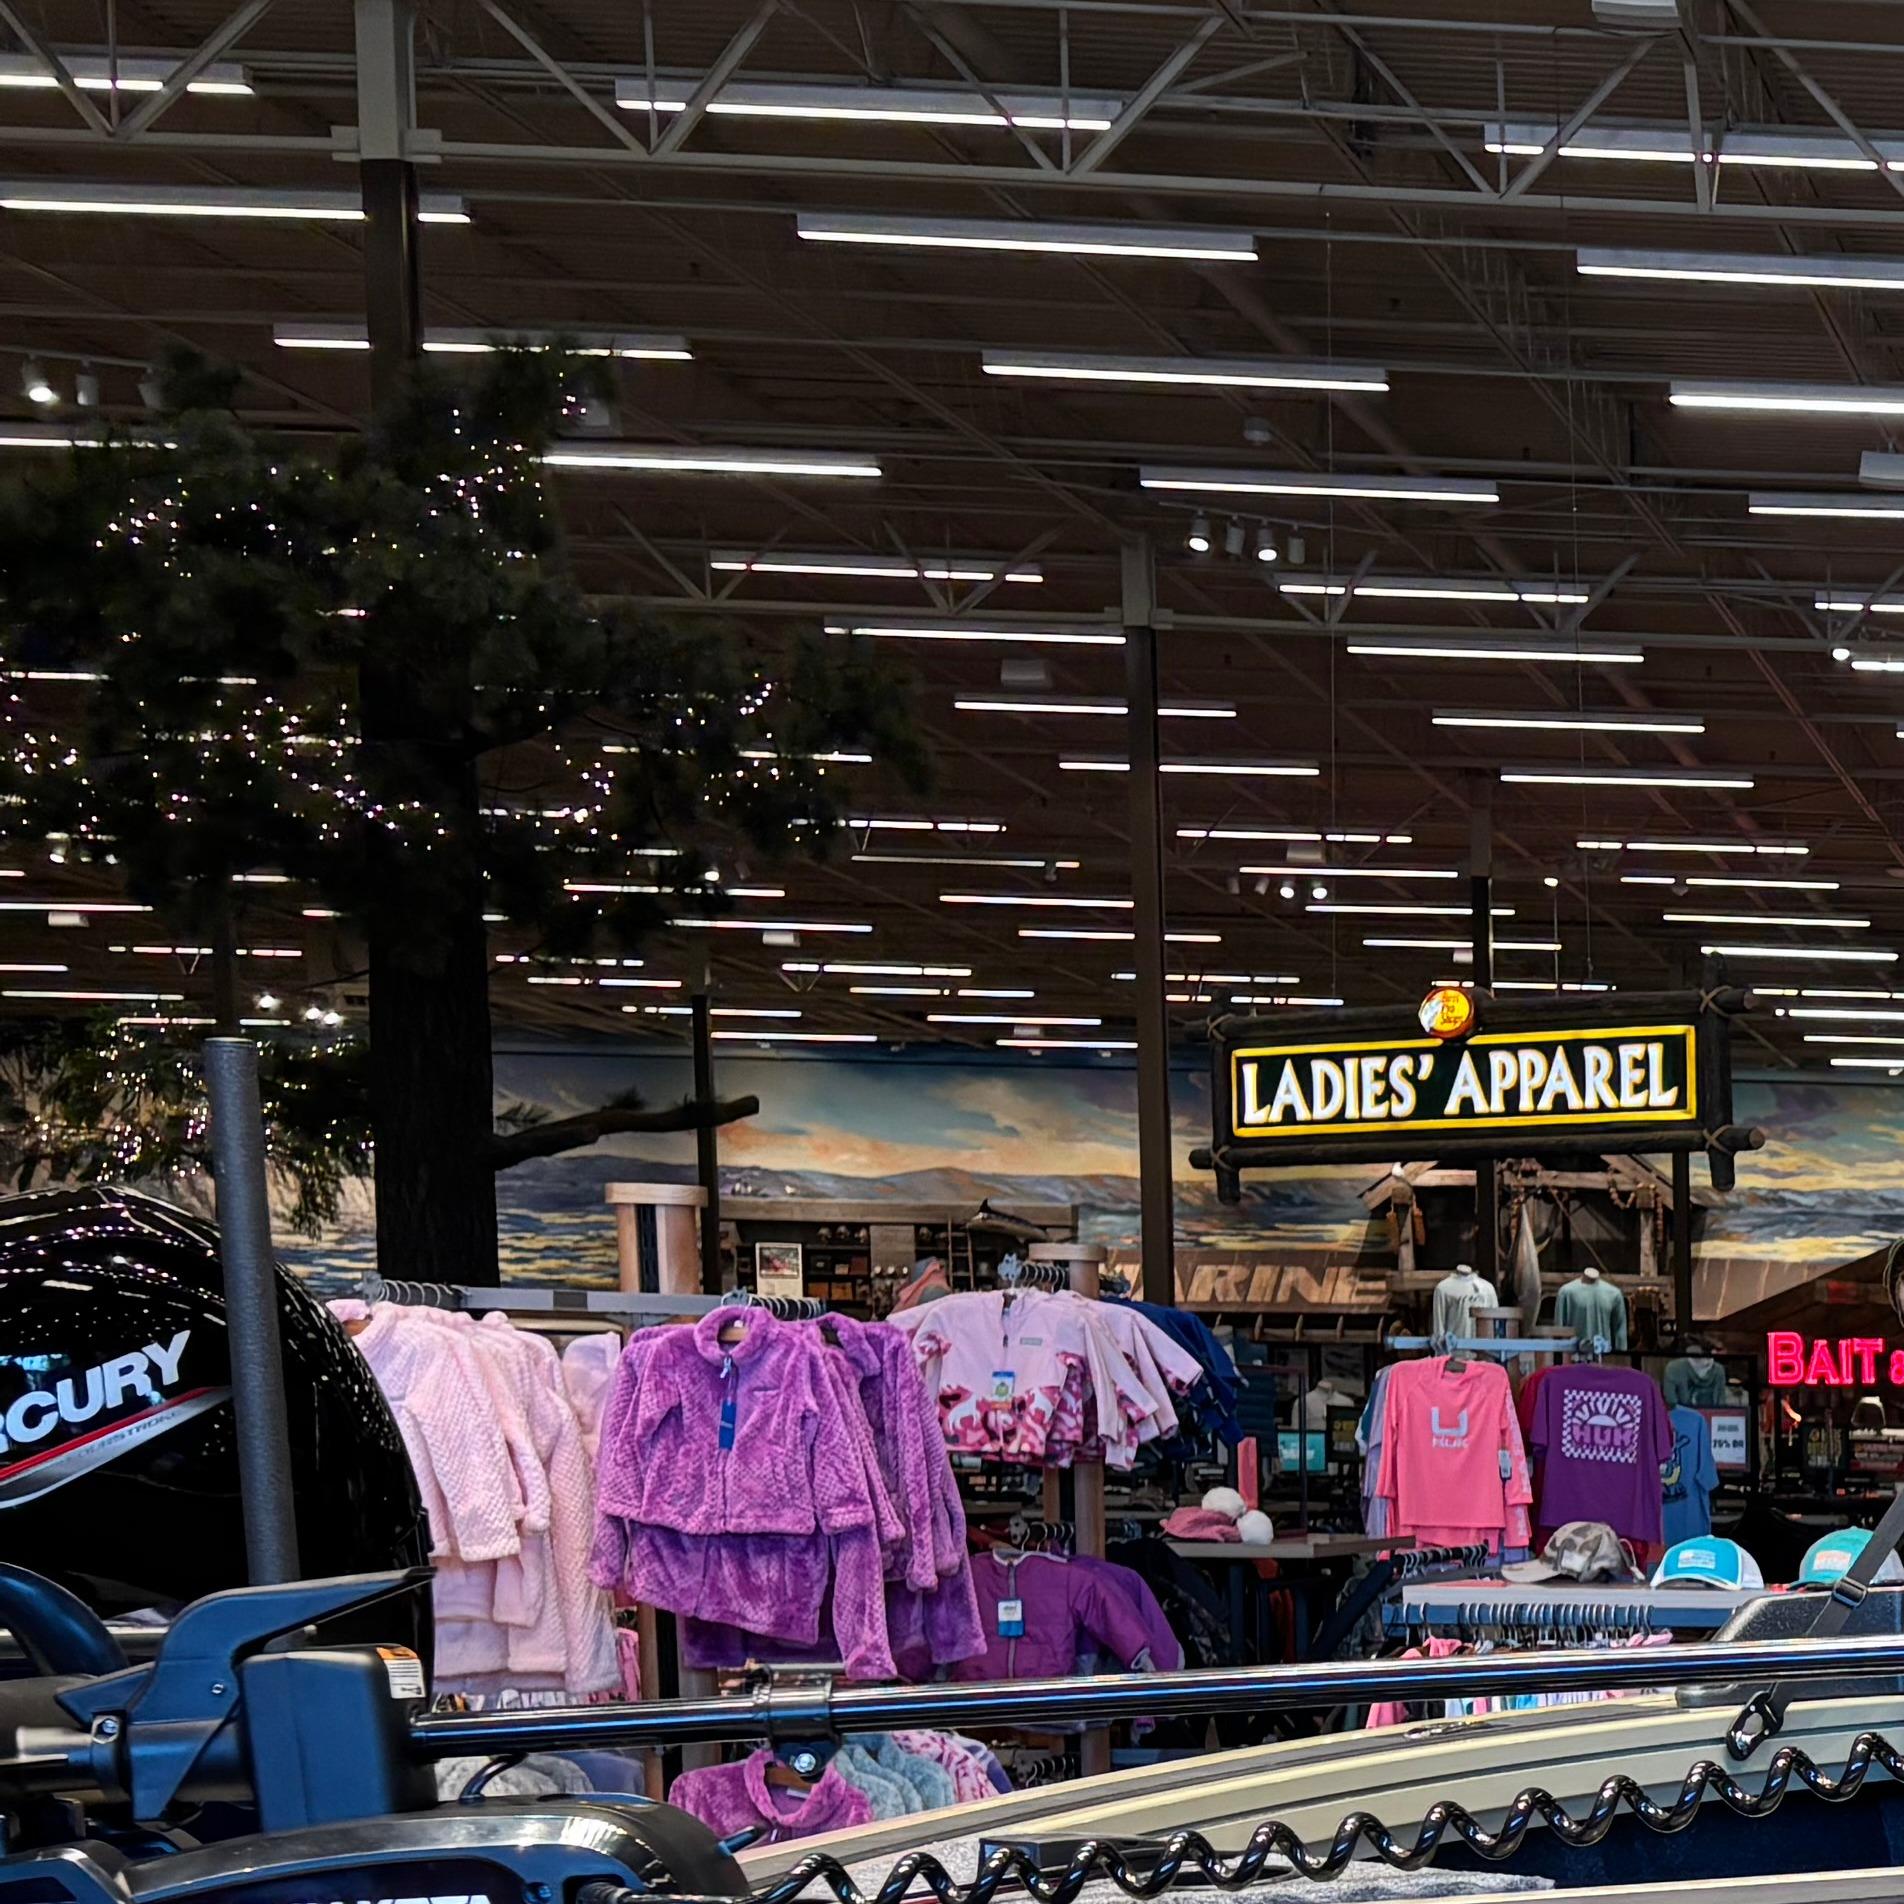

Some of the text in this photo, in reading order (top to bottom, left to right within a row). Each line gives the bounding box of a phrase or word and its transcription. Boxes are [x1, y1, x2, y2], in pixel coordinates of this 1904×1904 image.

[1242, 1042, 1678, 1125] LADIES' APPAREL
[1767, 1331, 1885, 1385] BAIT
